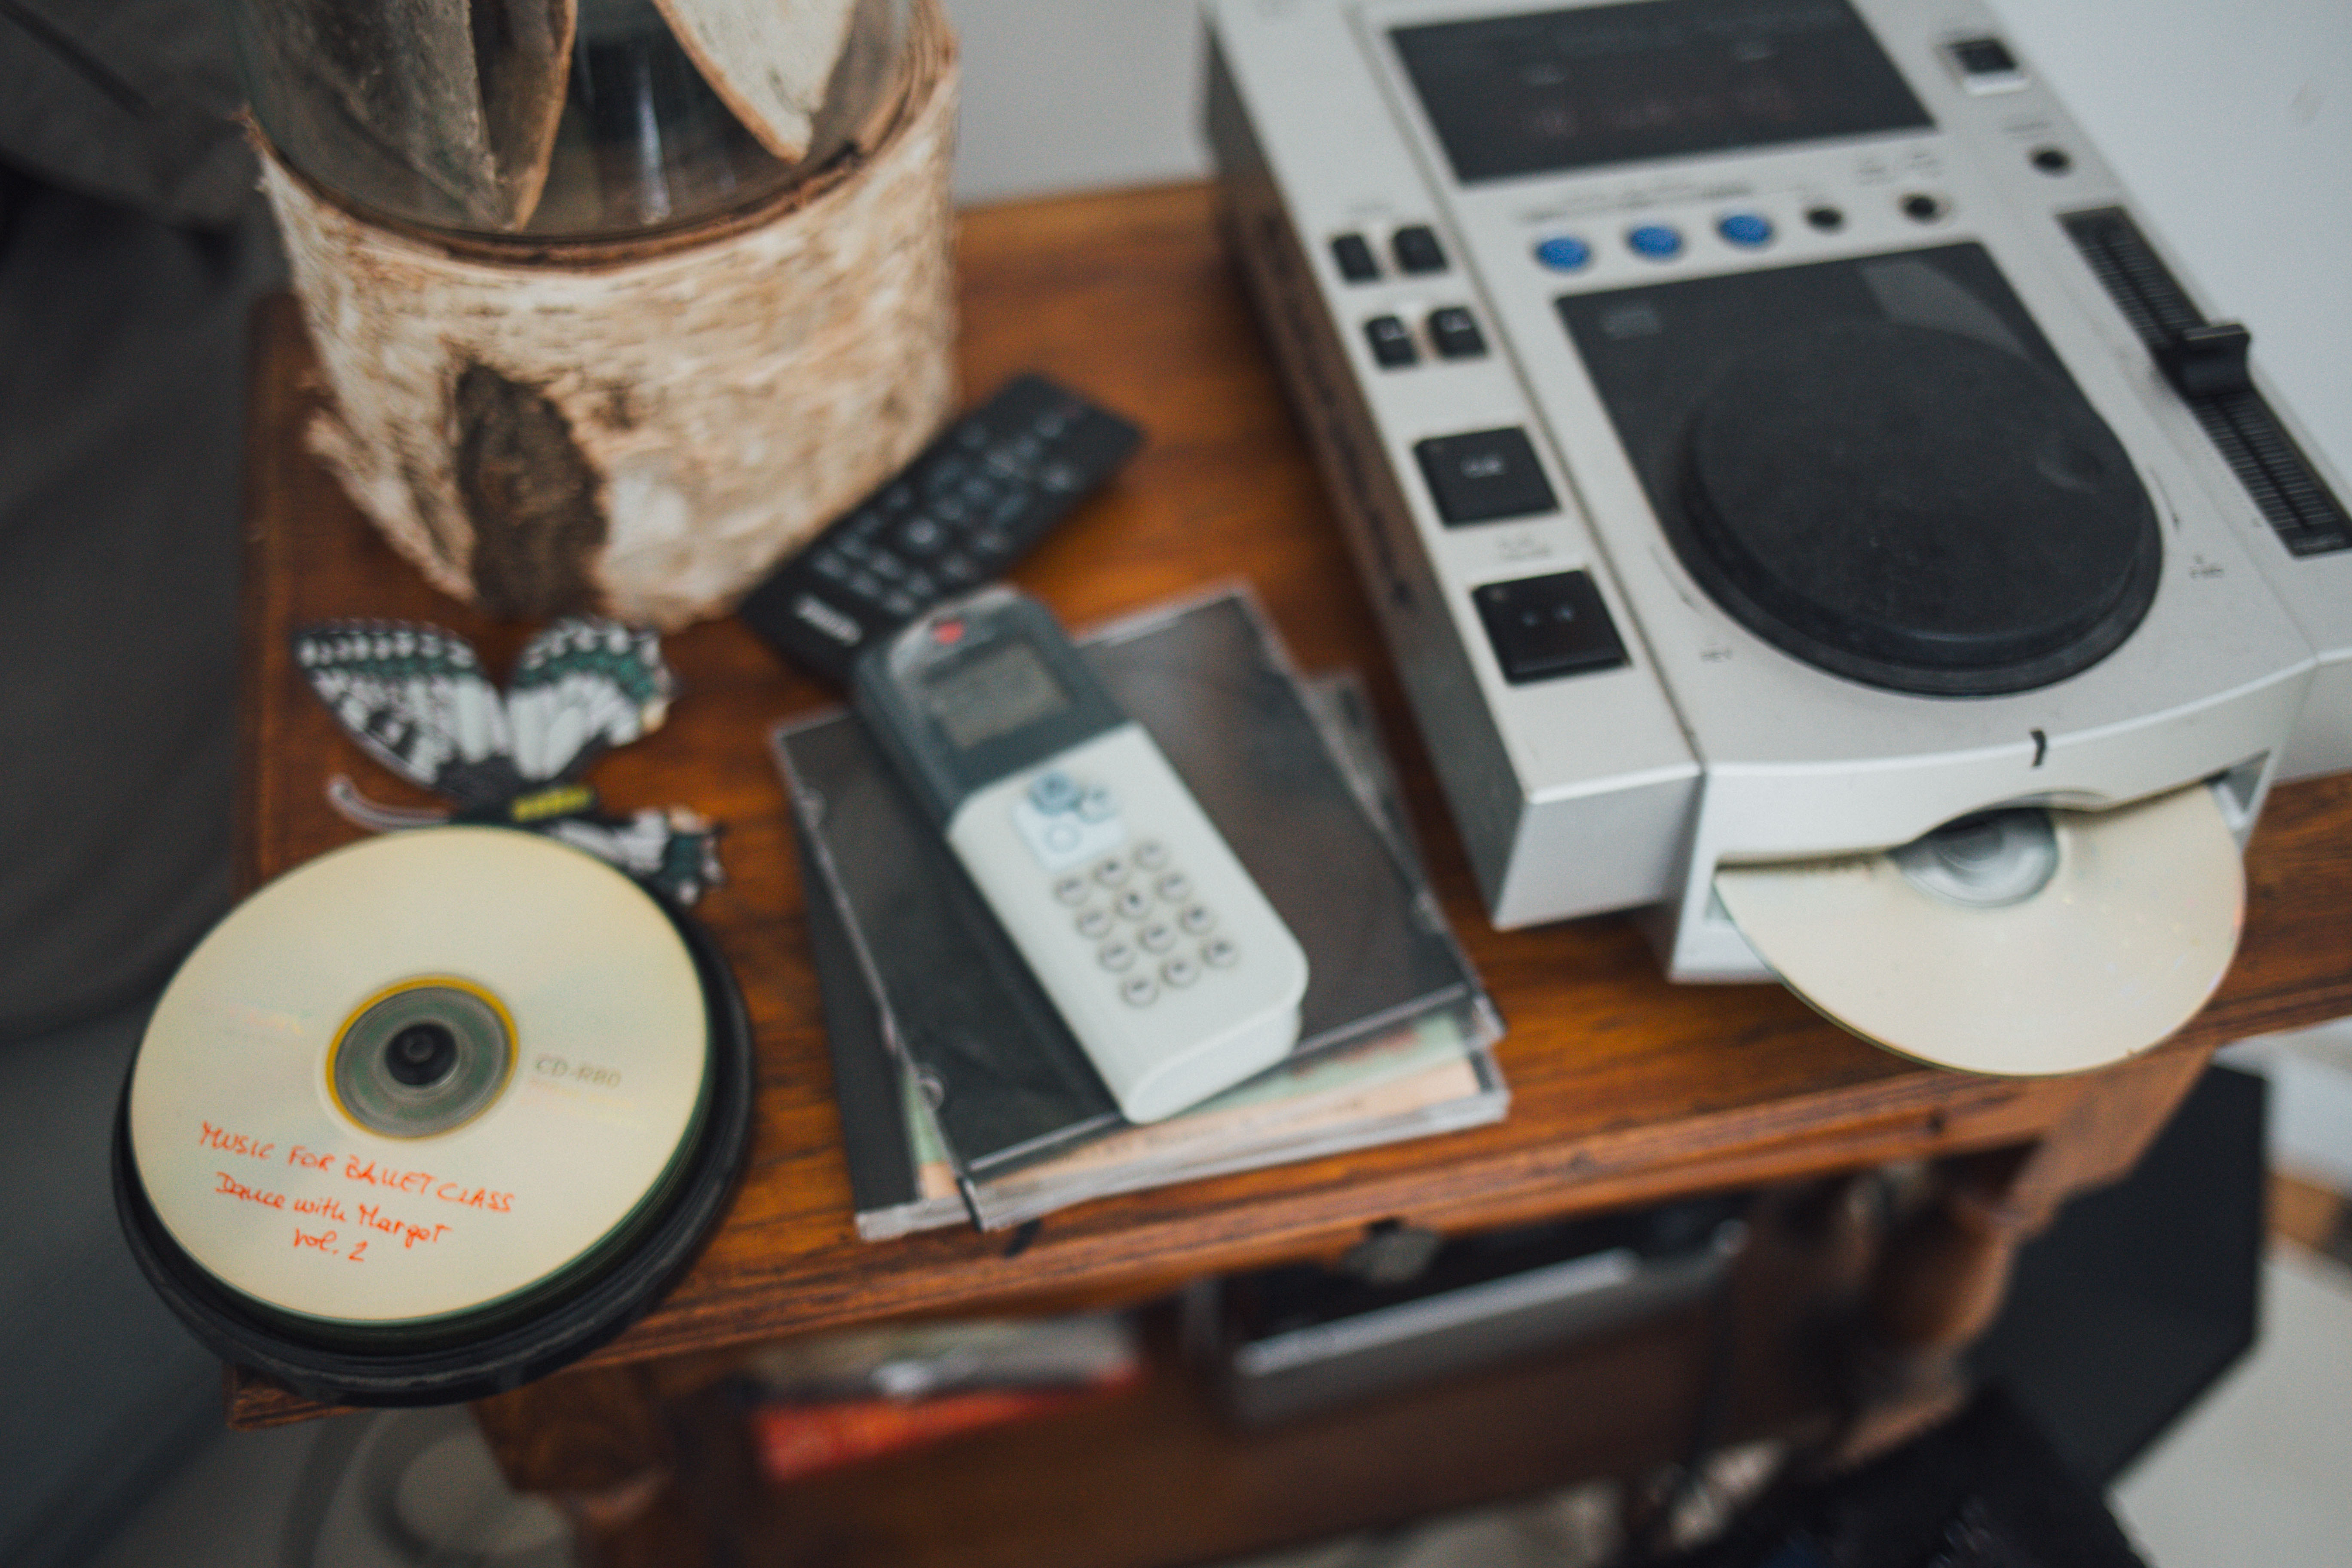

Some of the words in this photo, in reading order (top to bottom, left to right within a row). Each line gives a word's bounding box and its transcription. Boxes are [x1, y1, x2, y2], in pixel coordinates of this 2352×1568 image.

[199, 1120, 275, 1158] MUSIC
[287, 1144, 336, 1172] FOR
[345, 1154, 438, 1196] BALLET
[436, 1182, 515, 1213] CLASS
[215, 1170, 285, 1210] Dance
[294, 1197, 346, 1222] with
[349, 1240, 368, 1262] 2
